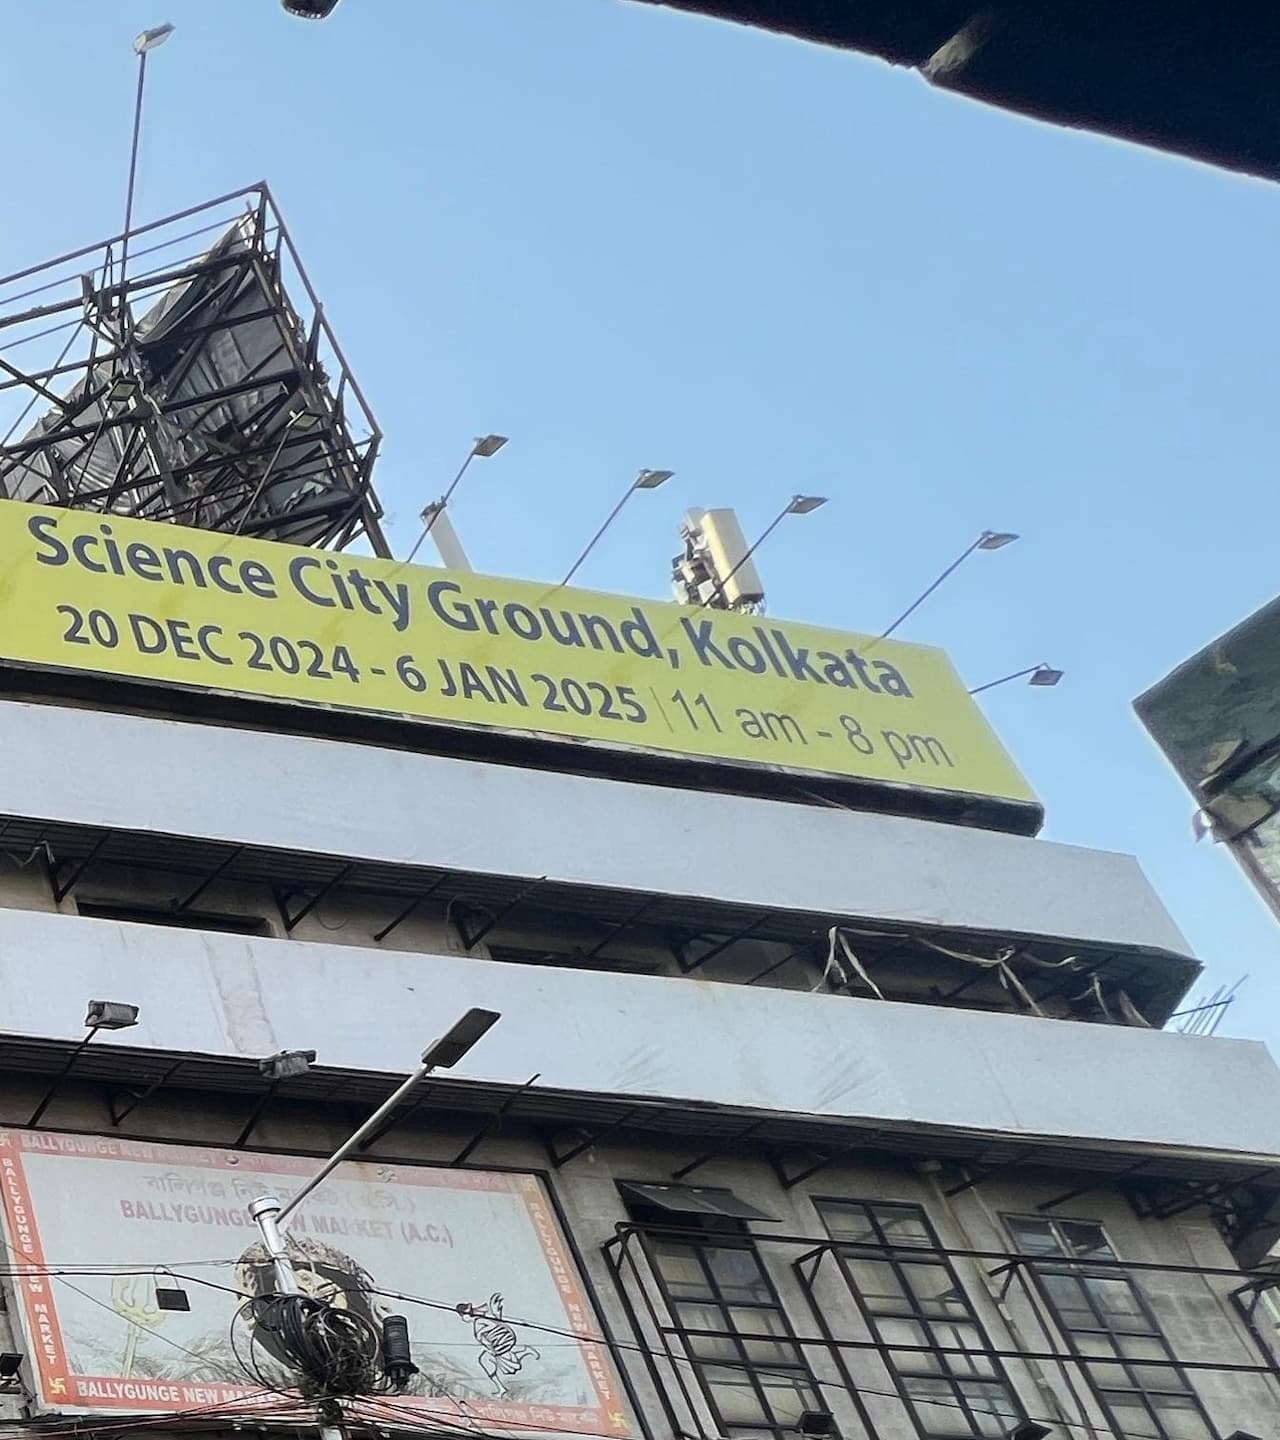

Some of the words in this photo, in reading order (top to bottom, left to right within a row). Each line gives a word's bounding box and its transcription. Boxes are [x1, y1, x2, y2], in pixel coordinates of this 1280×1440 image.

[28, 513, 278, 600] Science
[285, 553, 412, 632] City
[426, 577, 683, 671] Ground,
[686, 615, 915, 702] Kolkata
[56, 603, 120, 651] 20
[127, 613, 234, 668] DEC
[238, 629, 361, 687] 2024
[392, 652, 428, 694] 6
[437, 658, 530, 709] JAN
[530, 672, 649, 725] 2025
[676, 690, 727, 737] 11
[734, 702, 808, 749] am
[840, 716, 876, 760] 8
[882, 723, 956, 773] pm
[21, 1133, 118, 1156] BALLYGUNGE
[75, 1381, 180, 1402] BALLYGUNGE
[183, 1386, 219, 1405] NEW
